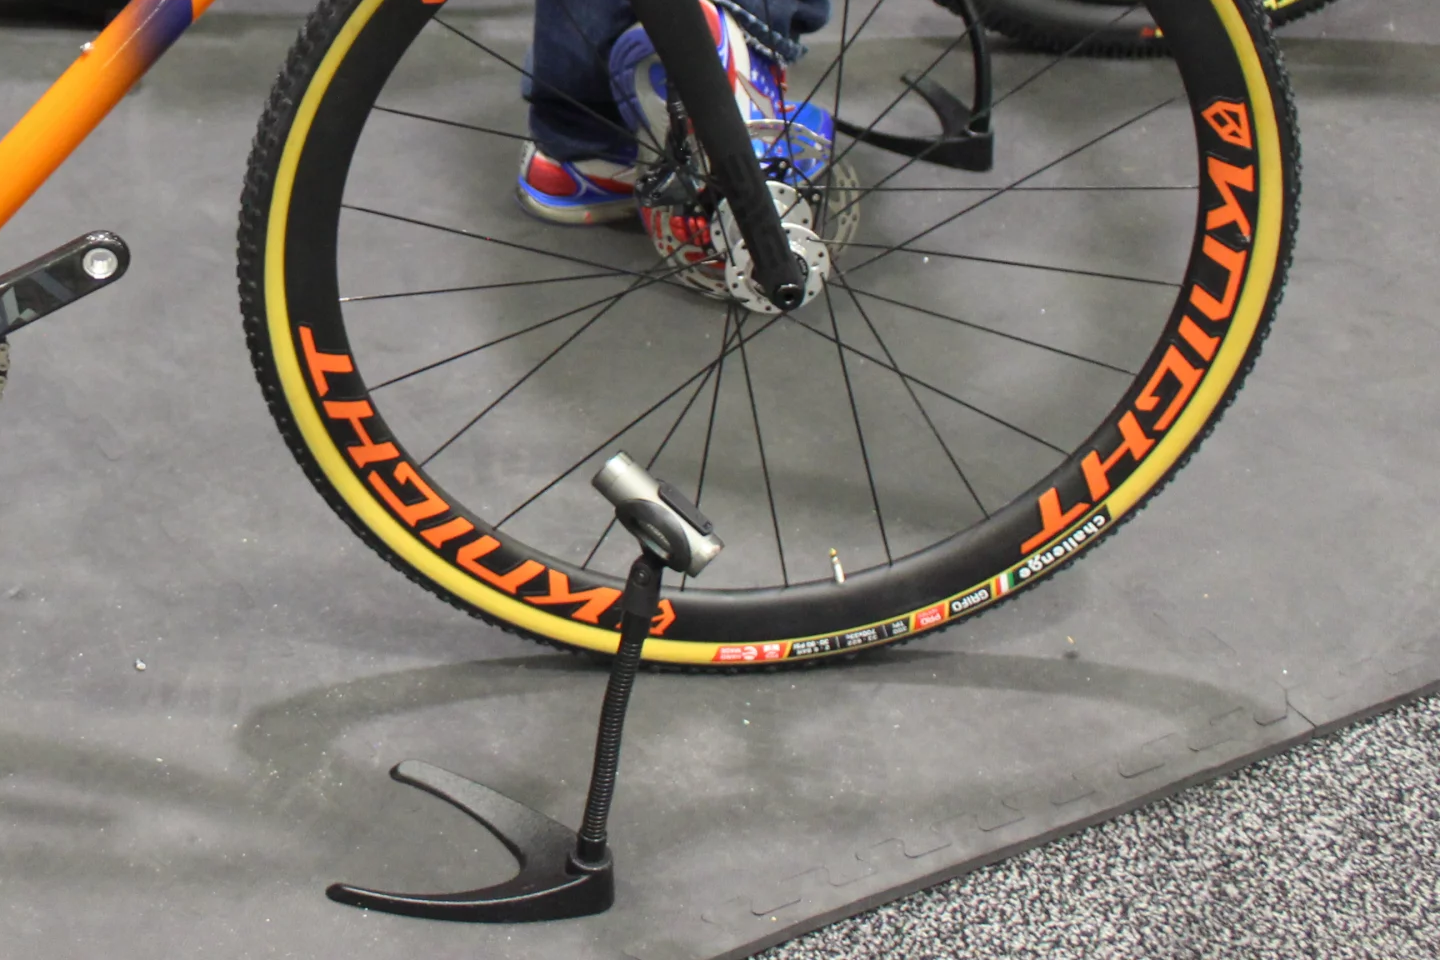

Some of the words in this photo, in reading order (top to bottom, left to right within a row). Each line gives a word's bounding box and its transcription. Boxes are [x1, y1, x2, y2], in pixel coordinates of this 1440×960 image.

[1020, 156, 1255, 555] KNIGHT
[299, 325, 624, 625] KNIGHT
[1018, 514, 1106, 579] challenge
[951, 588, 989, 612] GRIFO
